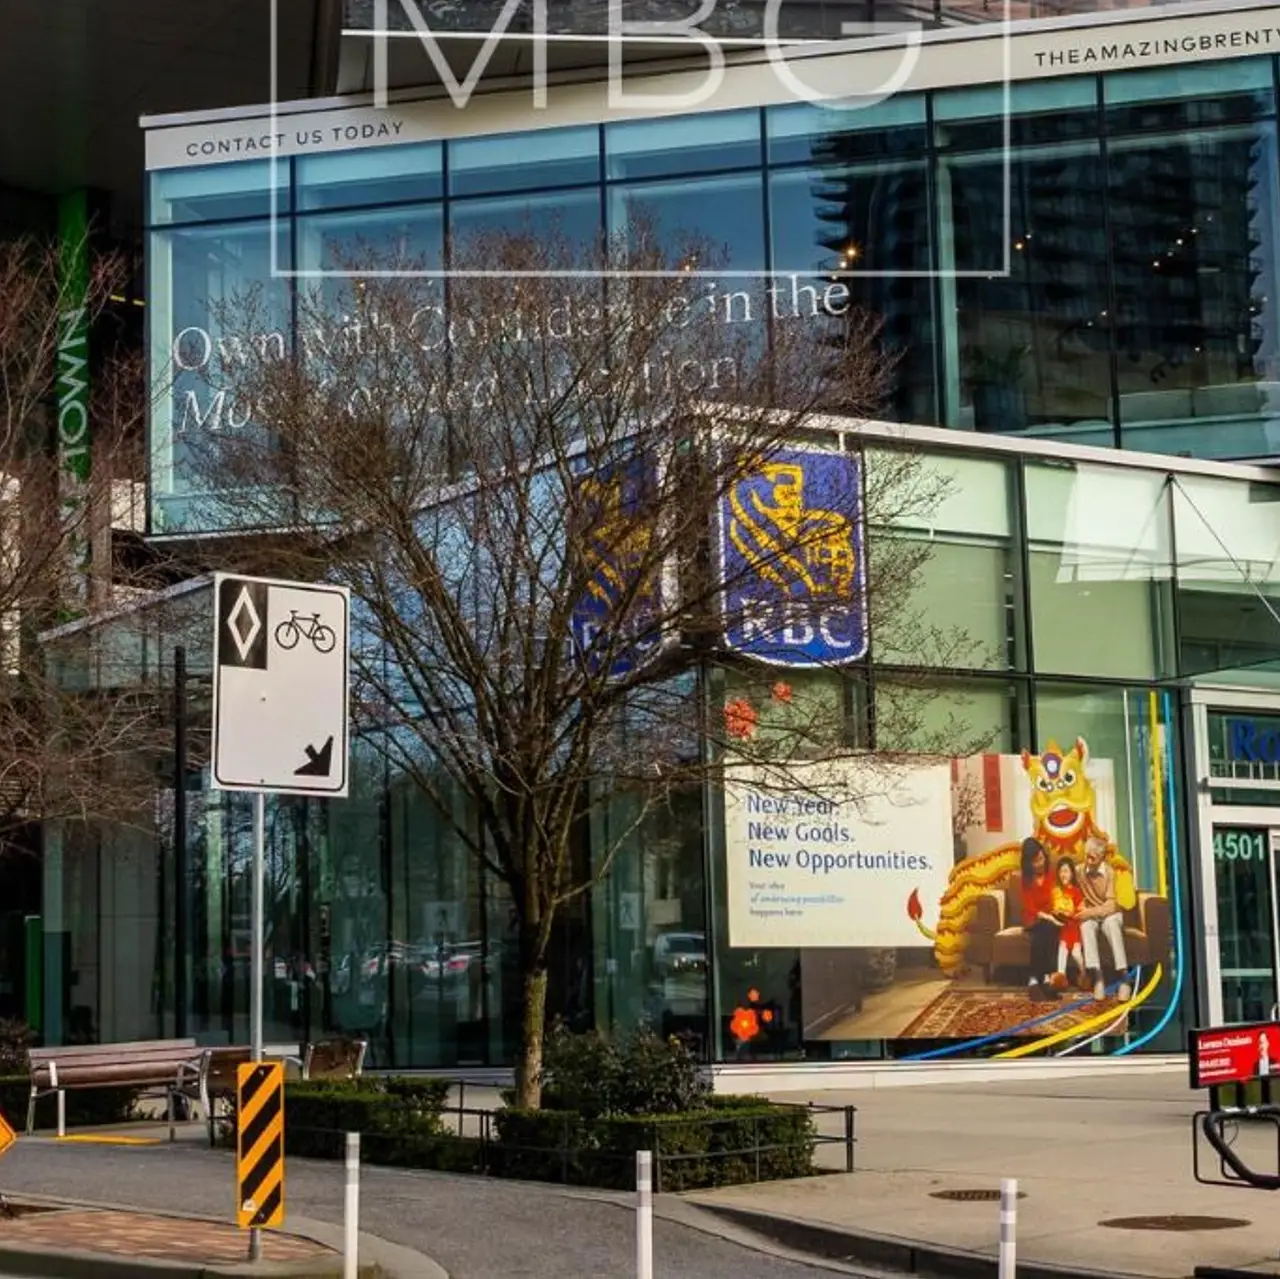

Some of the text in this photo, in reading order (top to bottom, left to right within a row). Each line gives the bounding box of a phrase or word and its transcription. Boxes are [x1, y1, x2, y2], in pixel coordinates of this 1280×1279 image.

[186, 122, 404, 157] CONTACT US TODAY
[706, 281, 753, 324] in
[766, 272, 851, 321] the
[747, 795, 840, 816] New Year.
[748, 822, 855, 843] New Goals.
[1213, 832, 1265, 862] 4501
[749, 849, 933, 874] New Opportunities.
